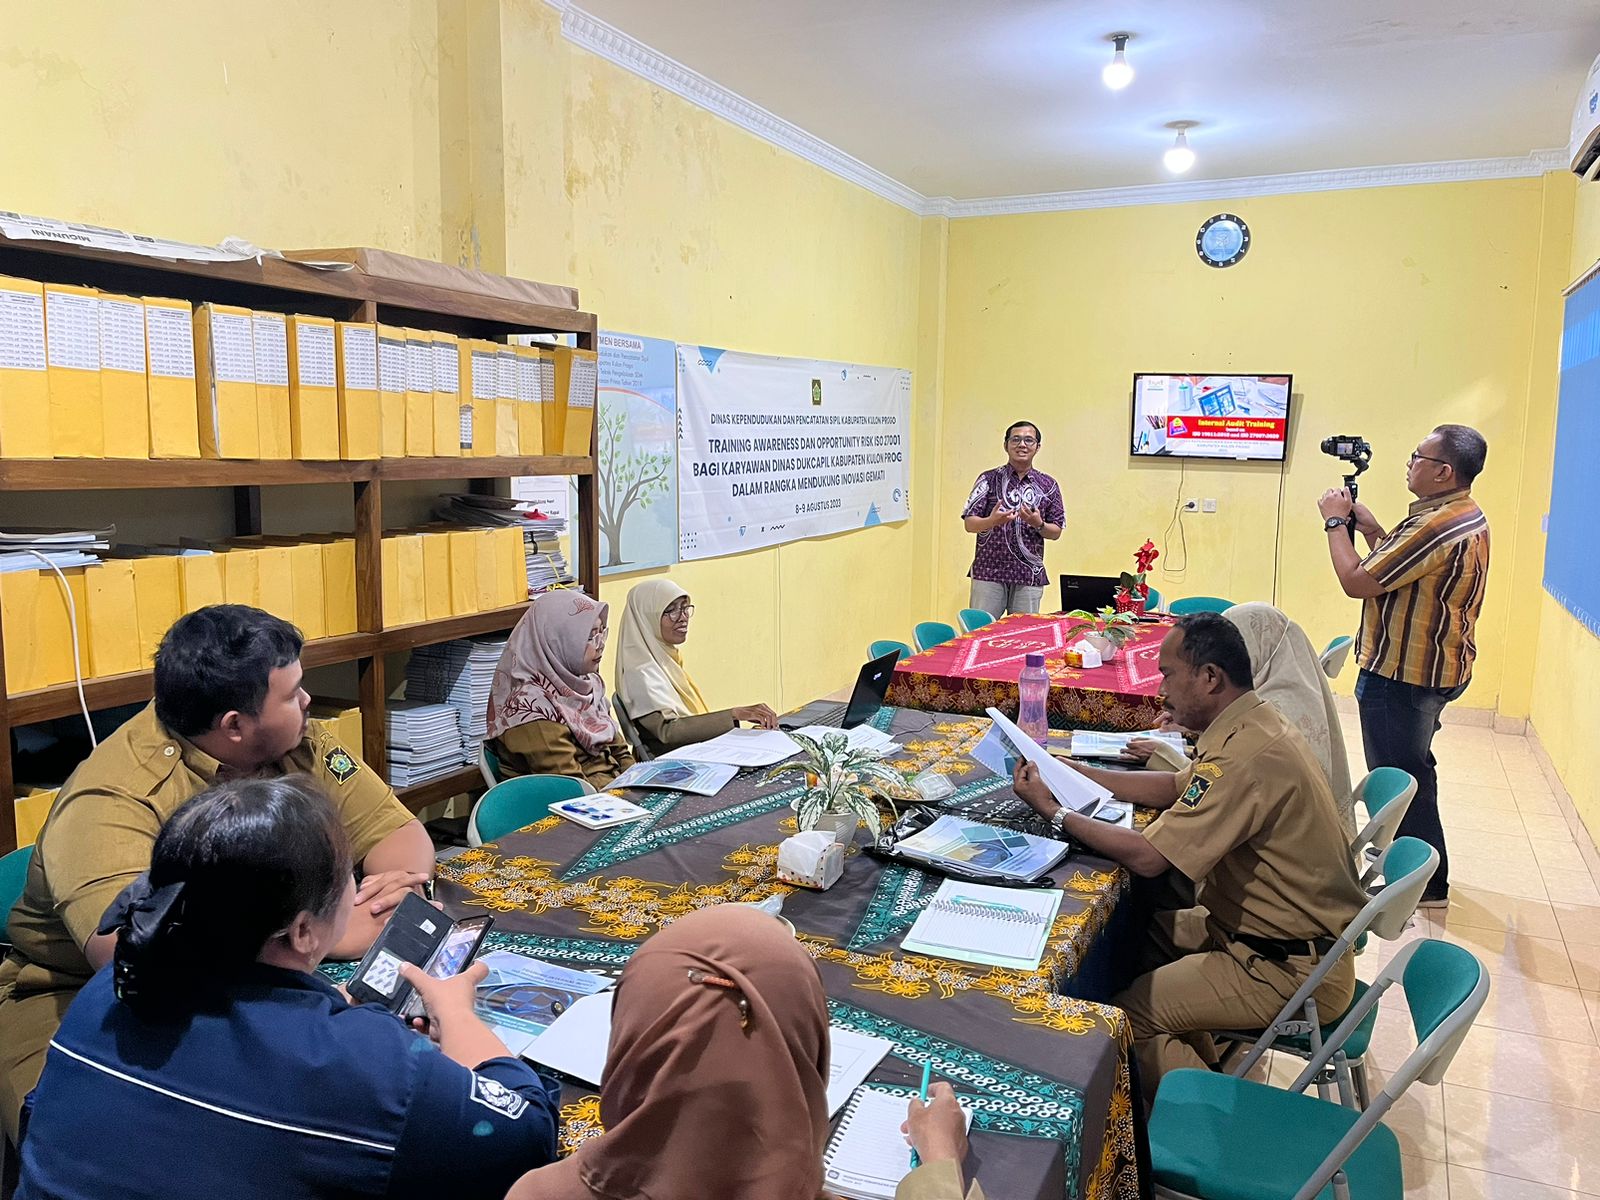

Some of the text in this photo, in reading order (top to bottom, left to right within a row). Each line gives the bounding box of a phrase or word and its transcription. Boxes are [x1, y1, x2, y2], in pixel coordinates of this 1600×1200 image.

[31, 229, 92, 242] MIGUNANI
[598, 336, 641, 350] MEN BERSAMA
[711, 413, 730, 424] DINAS
[732, 414, 782, 424] KEPENDUDUKAN
[783, 415, 795, 424] DAN
[796, 415, 829, 424] PENCATATAN
[830, 416, 840, 424] SIPIL
[841, 416, 867, 424] KABUPATEN
[868, 416, 881, 424] KULON
[1246, 421, 1275, 429] Training
[708, 435, 901, 453] TRAINING AWARENESS DAN OPPORTUNITY RISK ISO 27001
[693, 452, 902, 476] BAGI KARYAWAN DINAS DUKCAPIL KABUPATEN KULON PROG
[732, 470, 885, 497] DALAM RANGKA MENDUKUNG INOVASI GEMATI
[795, 498, 841, 514] 8-9 AGUSTUS 2023
